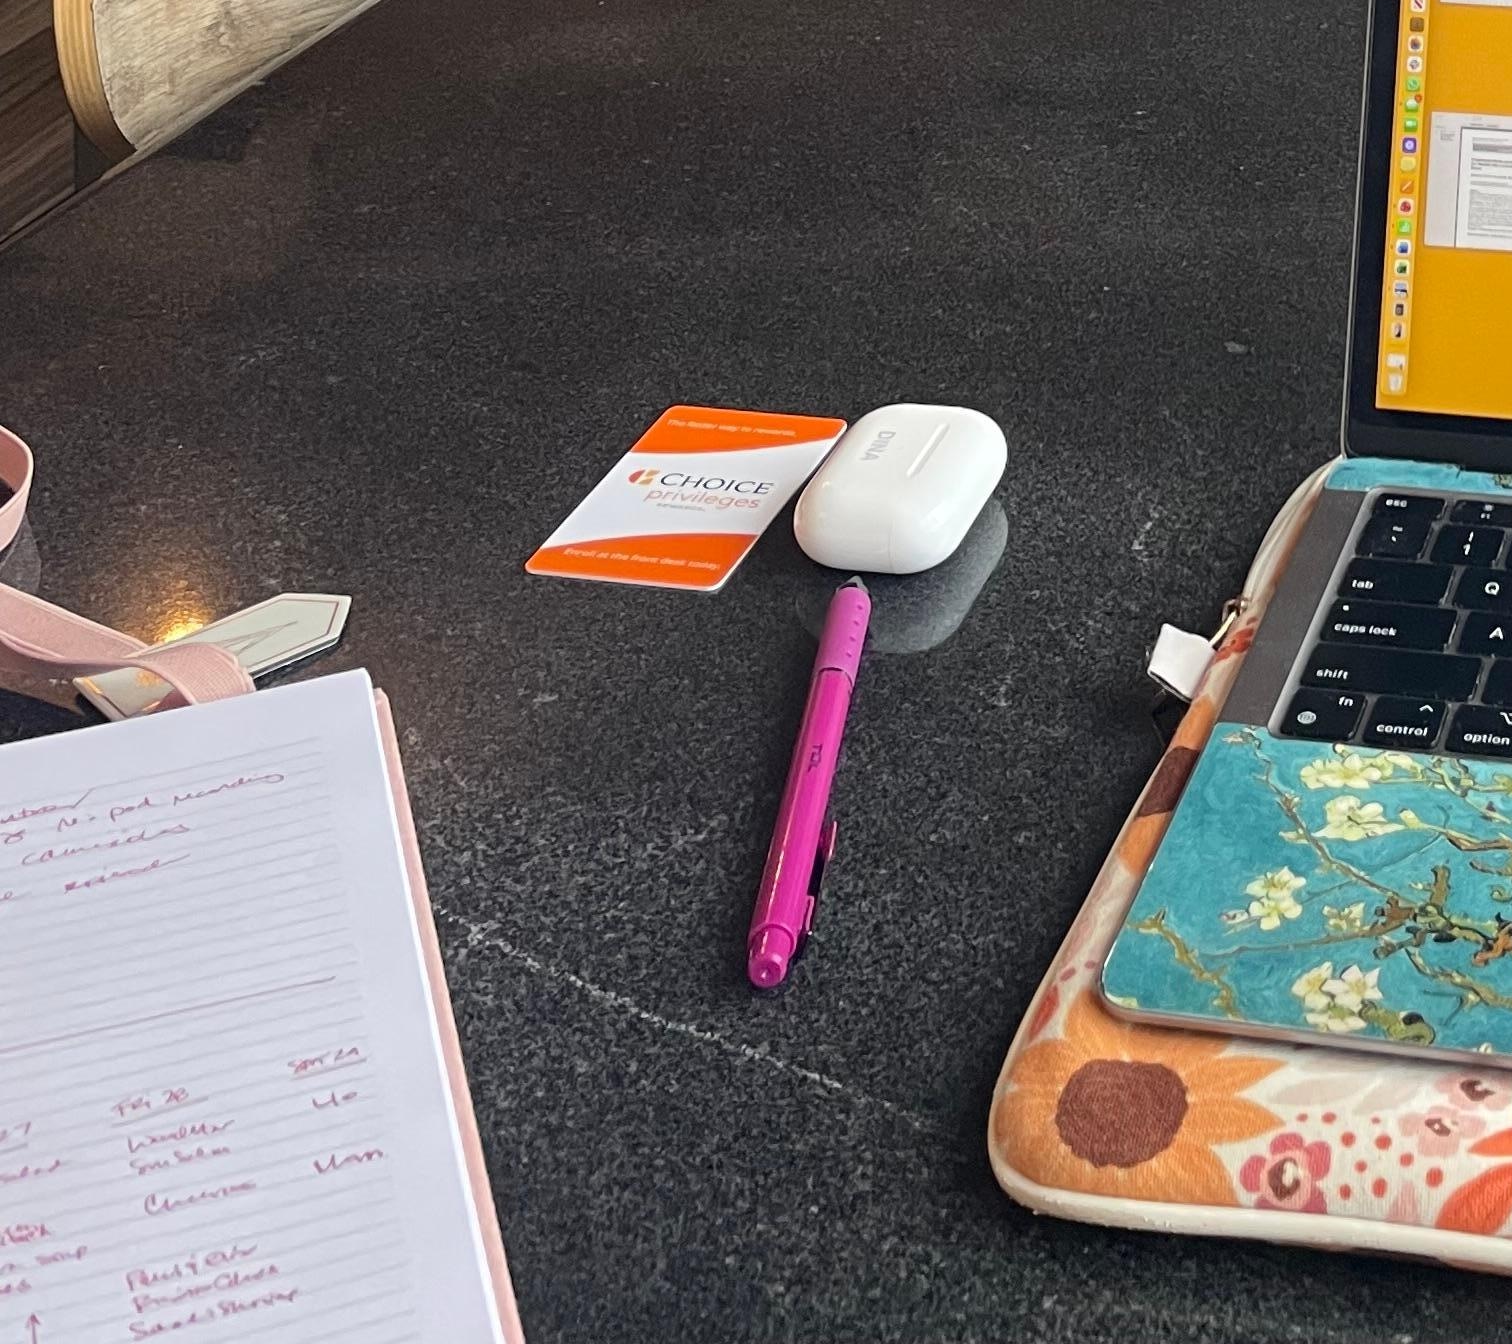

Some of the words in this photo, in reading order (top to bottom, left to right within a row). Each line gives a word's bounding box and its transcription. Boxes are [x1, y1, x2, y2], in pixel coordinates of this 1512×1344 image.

[659, 472, 775, 496] CHOICE
[643, 489, 762, 510] privileges
[1350, 578, 1375, 591] tab
[1483, 580, 1501, 597] Q
[1333, 622, 1367, 635] caps
[1367, 624, 1398, 637] lock
[1488, 625, 1505, 641] A
[1315, 667, 1350, 681] shift
[1337, 695, 1355, 708] fn
[1375, 723, 1429, 738] control
[1462, 732, 1512, 747] option
